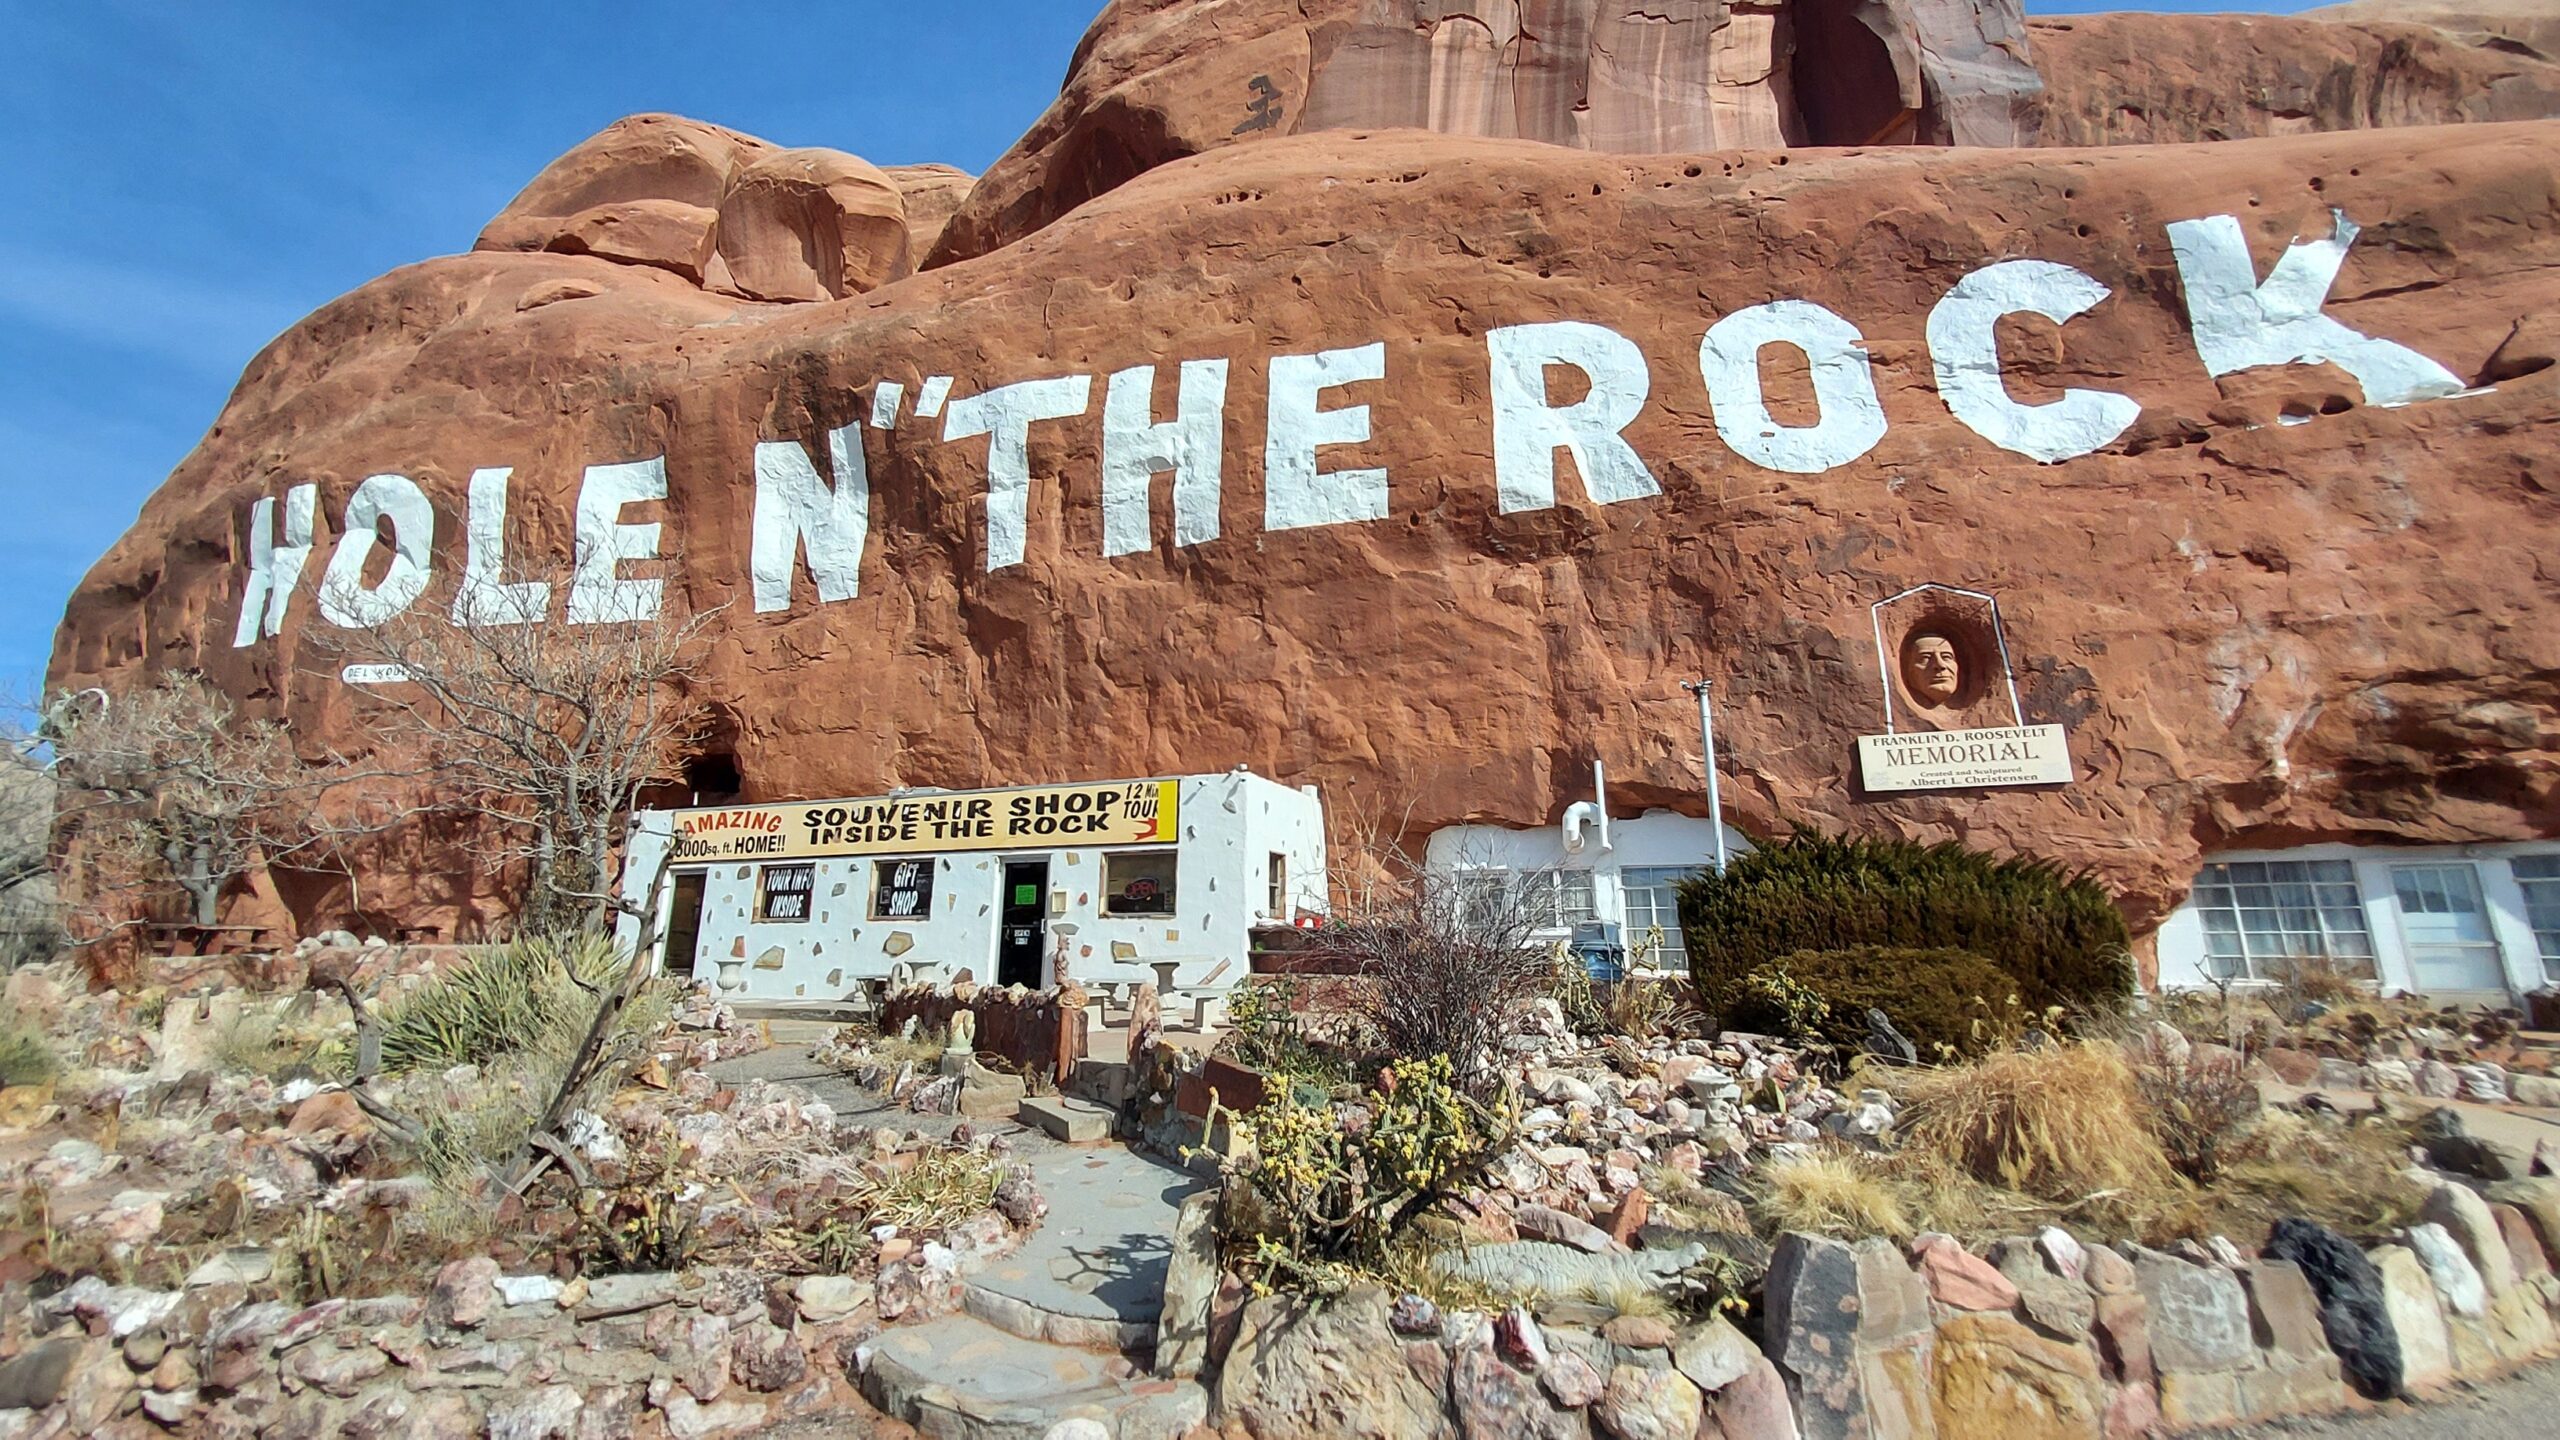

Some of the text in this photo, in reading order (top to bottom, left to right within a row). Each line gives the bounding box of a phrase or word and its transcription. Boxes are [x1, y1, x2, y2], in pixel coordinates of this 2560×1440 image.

[233, 455, 668, 648] HOLE
[943, 342, 1389, 573] THE
[1486, 207, 2474, 515] ROCK
[1873, 727, 2048, 747] FRANKLIN D. ROOSEVELT
[1886, 741, 2040, 767] MEMORIAL
[1910, 777, 1947, 787] Albert
[1964, 773, 2039, 784] Christensen
[1920, 769, 1953, 777] Created
[1974, 766, 2023, 776] Sculptured
[1126, 782, 1144, 800] 12
[803, 790, 1121, 828] SOUVENIR SHOP
[682, 810, 783, 836] AMAZING
[810, 813, 1111, 845] INSIDE THE ROCK
[734, 834, 786, 855] HOME!!
[766, 866, 815, 892] TOUR INFO
[893, 863, 920, 888] GIFT
[770, 894, 805, 918] INSIDE
[889, 890, 919, 916] SHOP
